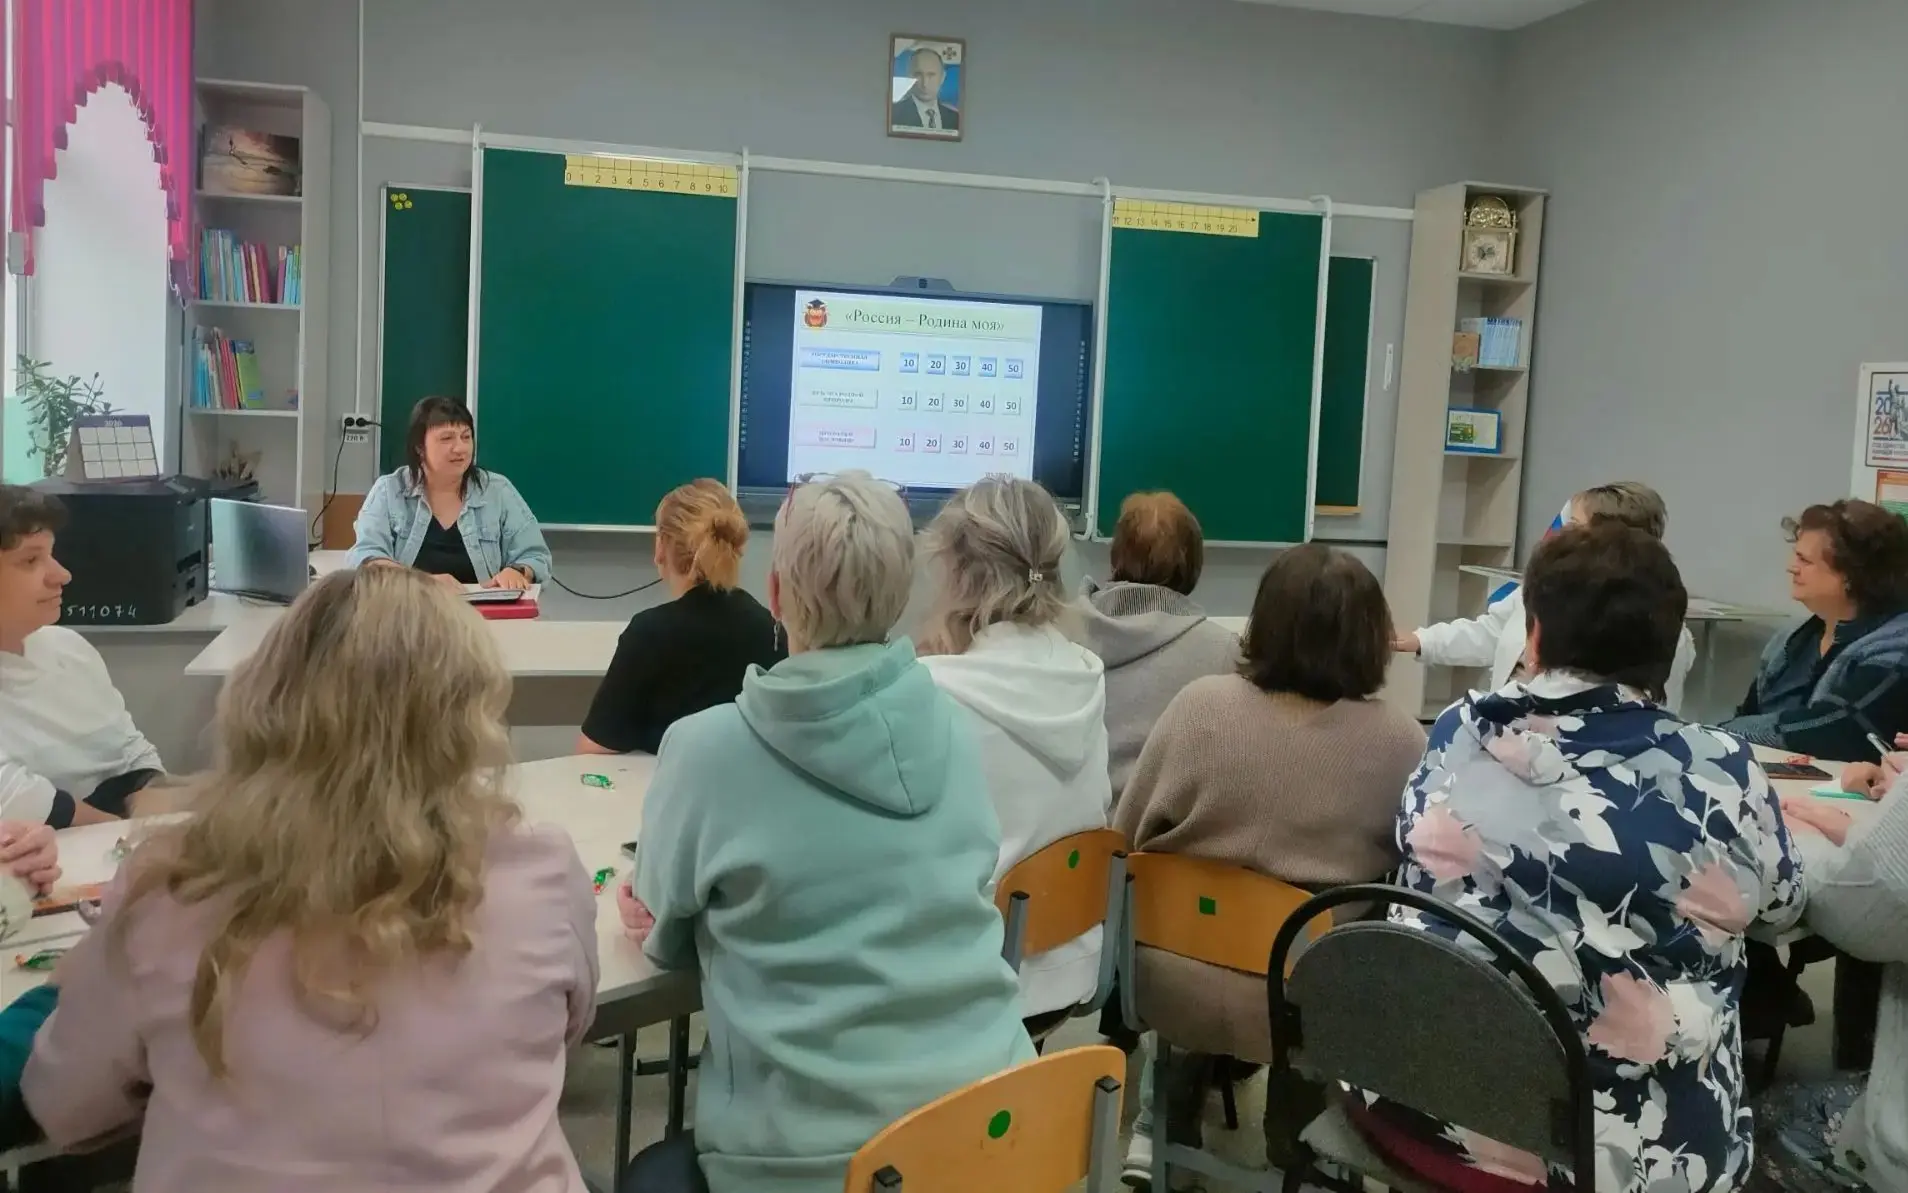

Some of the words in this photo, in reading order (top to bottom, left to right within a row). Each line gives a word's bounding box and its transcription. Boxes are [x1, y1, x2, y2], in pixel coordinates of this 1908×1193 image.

[566, 172, 572, 182] 0
[580, 173, 584, 182] 1
[595, 175, 601, 184] 2
[612, 176, 617, 185] 3
[627, 177, 633, 186] 4
[643, 178, 649, 187] 5
[659, 180, 665, 188] 6
[674, 181, 680, 189] 7
[690, 182, 696, 190] 8
[705, 183, 711, 192] 9
[719, 185, 728, 193] 10
[1137, 218, 1144, 226] 13
[1151, 219, 1158, 227] 14
[1164, 220, 1172, 228] 15
[1178, 221, 1185, 229] 16
[1191, 222, 1198, 230] 17
[1204, 222, 1211, 231] 18
[1217, 224, 1224, 232] 19
[1228, 224, 1238, 233] 20
[845, 309, 901, 325] «Россия
[919, 313, 967, 330] Родина
[971, 319, 1005, 331] моя»
[903, 359, 915, 367] 10
[930, 360, 942, 369] 20
[955, 361, 966, 370] 30
[981, 363, 993, 371] 40
[1008, 364, 1019, 373] 50
[901, 396, 913, 405] 10
[928, 398, 939, 406] 20
[953, 399, 964, 407] 30
[980, 400, 991, 408] 40
[1005, 401, 1017, 410] 50
[899, 438, 911, 446] 10
[926, 439, 937, 447] 20
[952, 440, 964, 448] 30
[979, 441, 990, 449] 40
[1003, 442, 1014, 451] 50
[67, 604, 137, 620] 511074
